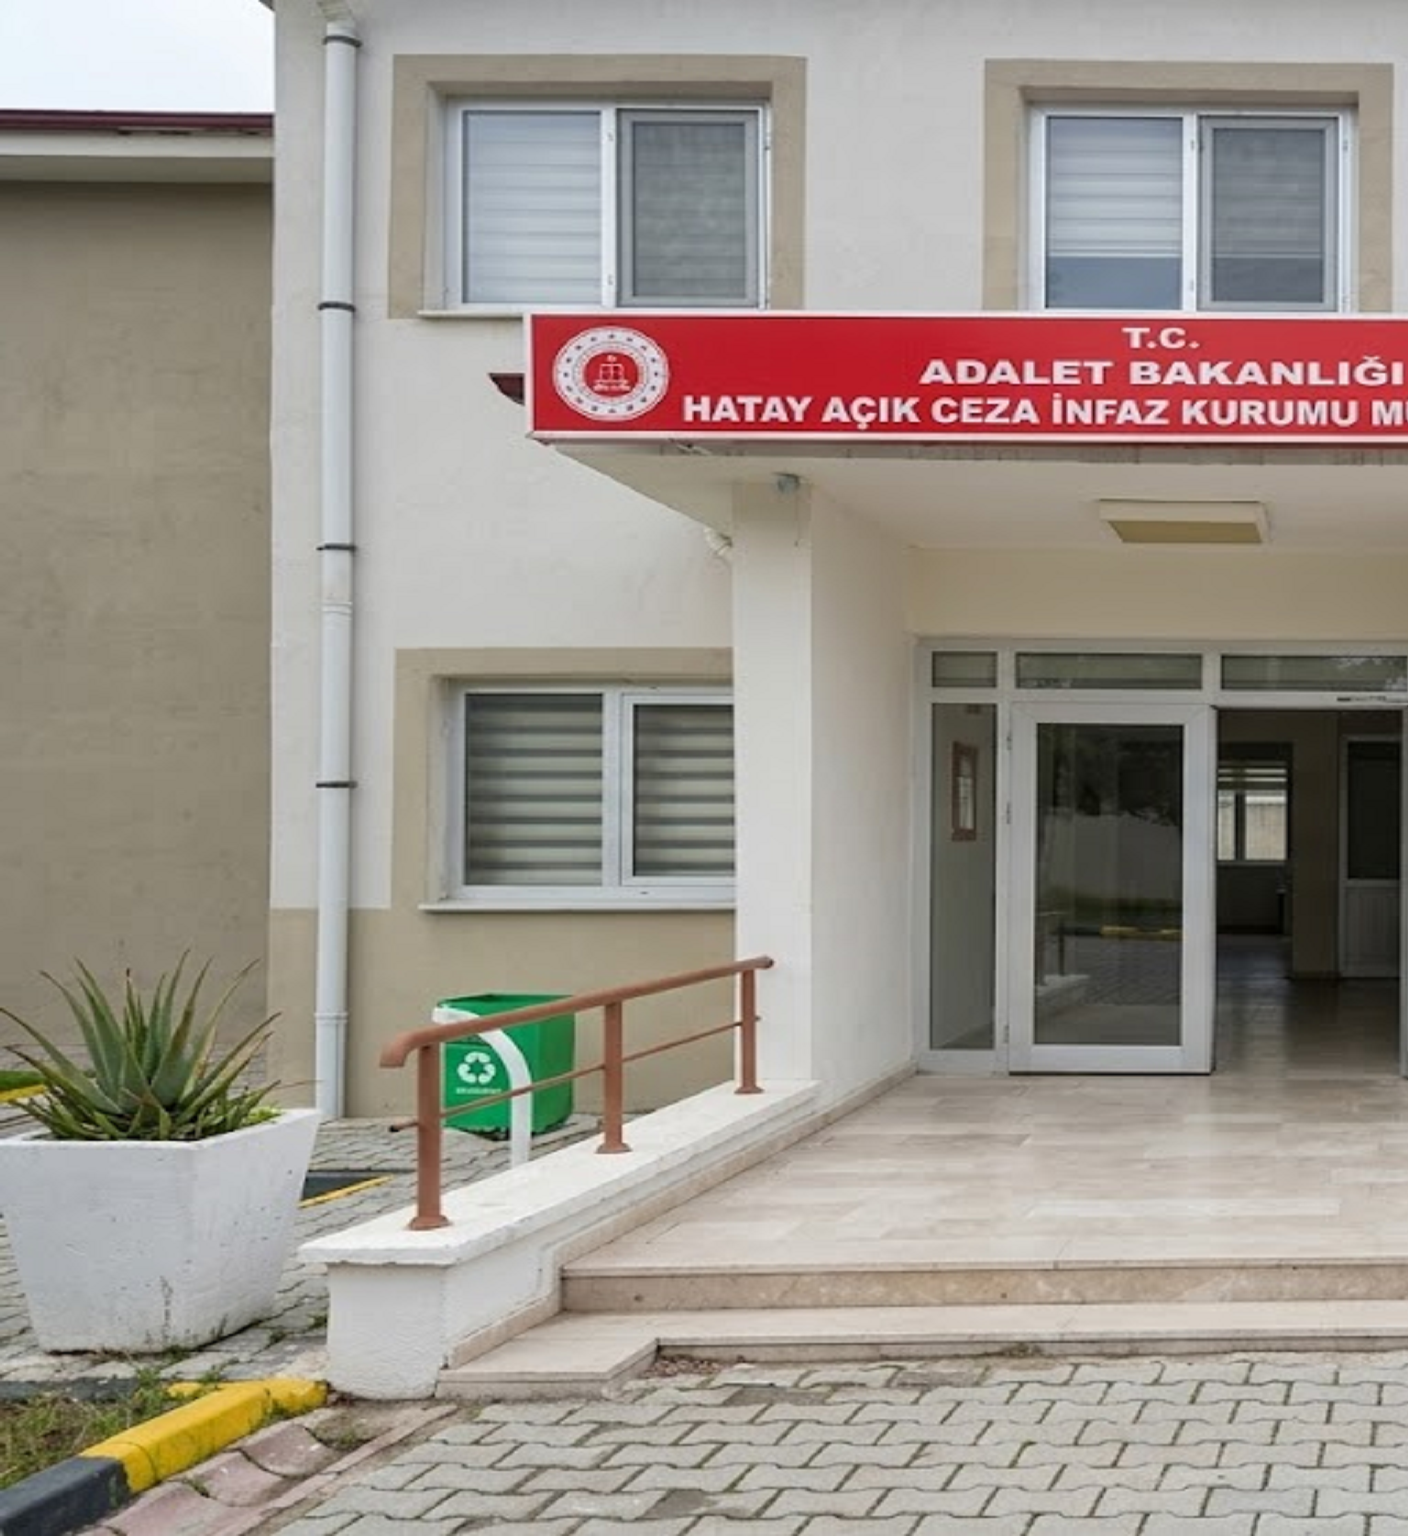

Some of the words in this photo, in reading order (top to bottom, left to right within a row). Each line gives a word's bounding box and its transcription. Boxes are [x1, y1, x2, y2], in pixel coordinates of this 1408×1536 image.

[1122, 327, 1199, 349] T.C.
[920, 360, 1114, 385] ADALET
[1129, 355, 1404, 386] BAKANLIĞI
[683, 395, 812, 423] HATAY
[821, 396, 920, 430] AÇIK
[931, 397, 1040, 424] CEZA
[1052, 392, 1169, 425] İNFAZ
[1182, 399, 1358, 427] KURUMU
